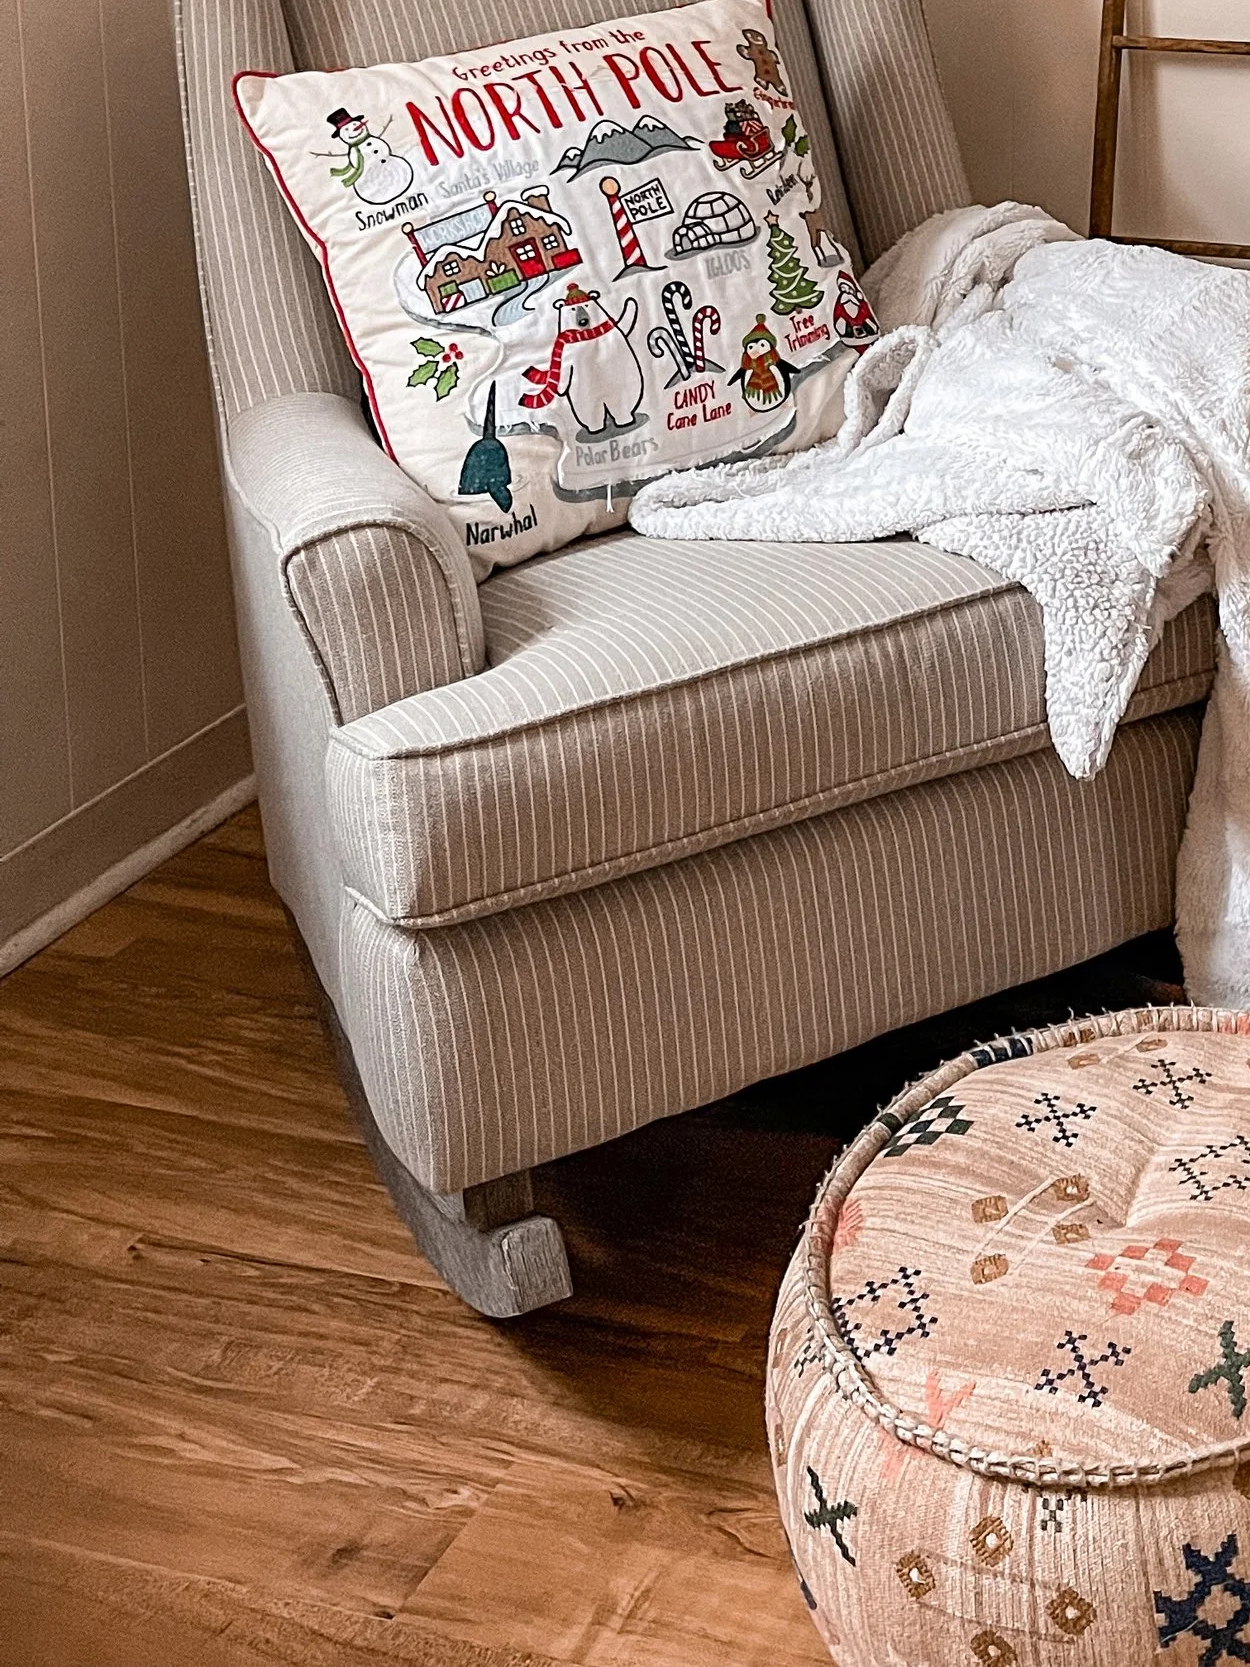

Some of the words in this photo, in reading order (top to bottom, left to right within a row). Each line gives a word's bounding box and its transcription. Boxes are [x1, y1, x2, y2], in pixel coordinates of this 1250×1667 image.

[452, 46, 557, 81] Greetings
[559, 36, 609, 55] from
[609, 29, 646, 45] the
[405, 61, 604, 166] NORTH
[602, 40, 744, 110] POLE
[437, 167, 493, 198] Santa's
[492, 158, 539, 184] Village
[624, 183, 661, 207] NORTH
[630, 196, 667, 221] POLE
[355, 191, 430, 232] Snowman
[704, 250, 750, 280] IGLOOS
[784, 323, 830, 352] Trimming
[789, 315, 815, 333] Tree
[674, 380, 717, 410] CANDY
[667, 410, 698, 431] Cane
[703, 402, 732, 423] Lane
[575, 444, 608, 467] Polar
[610, 437, 659, 462] Bears
[465, 503, 538, 547] Narwhal
